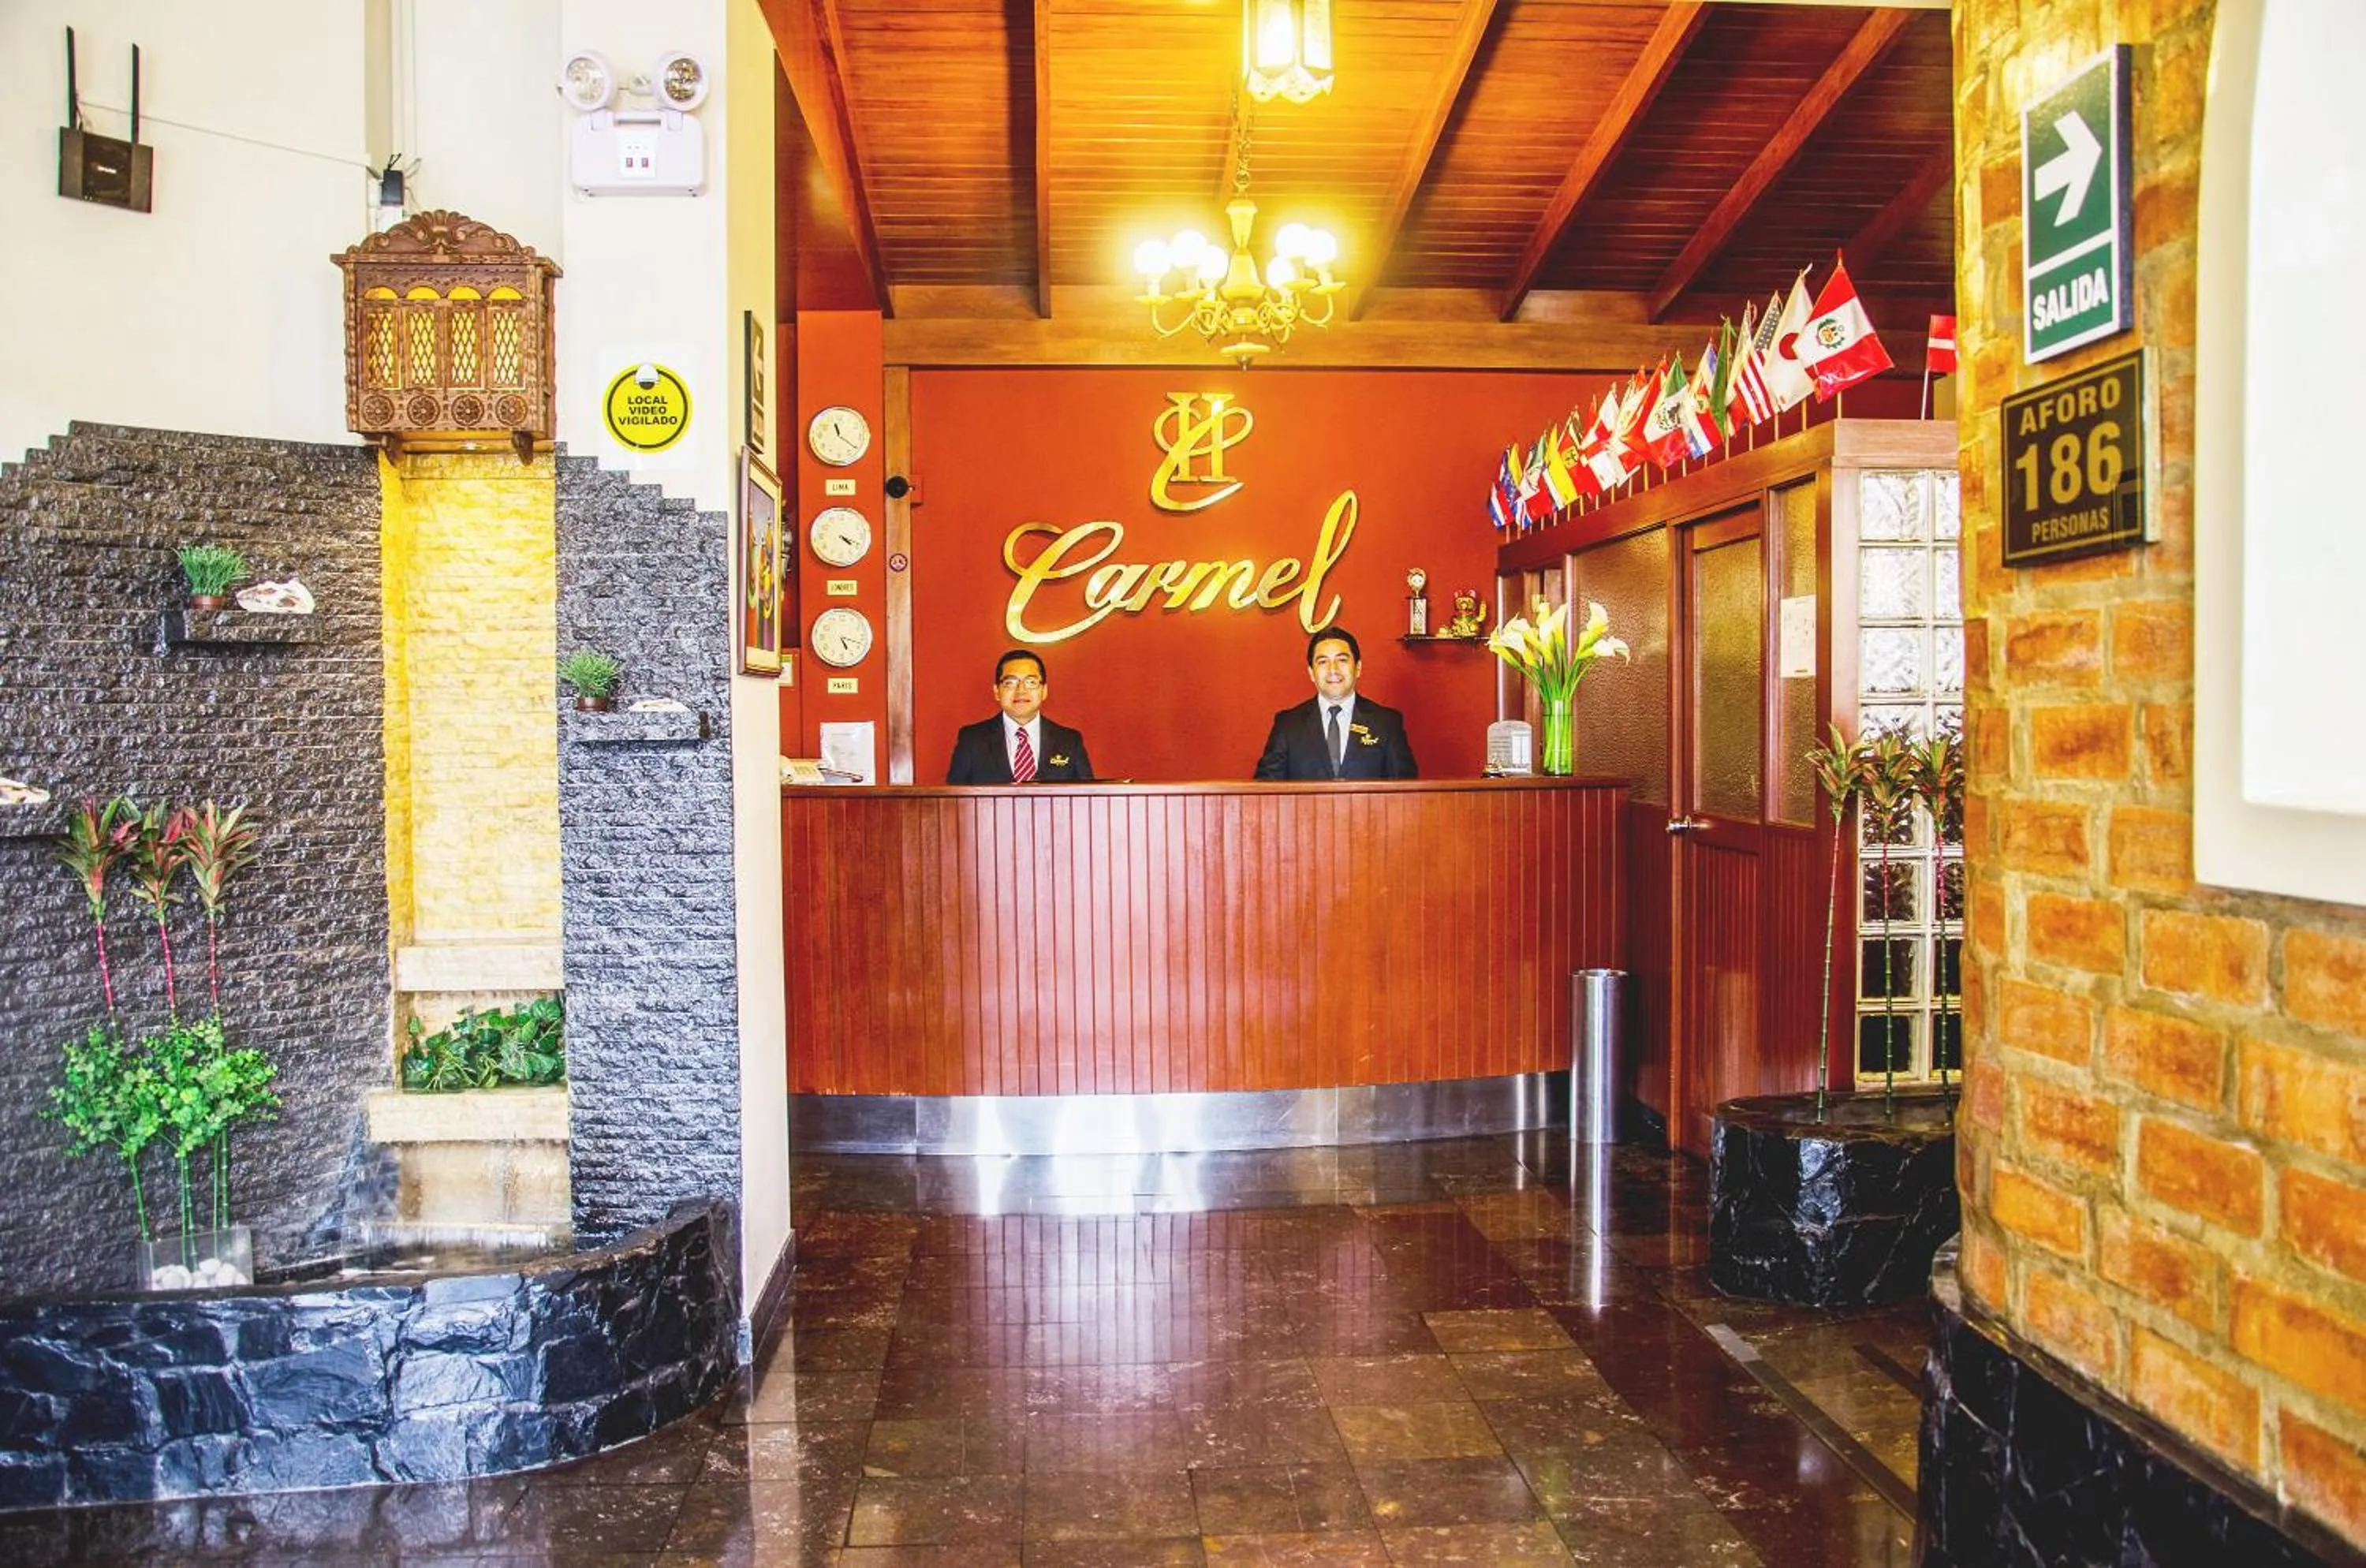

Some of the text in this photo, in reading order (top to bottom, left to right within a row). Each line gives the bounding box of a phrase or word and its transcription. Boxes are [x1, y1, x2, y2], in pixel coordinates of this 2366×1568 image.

[2032, 267, 2109, 331] SALIDA
[627, 395, 668, 405] LOCAL
[629, 406, 666, 415] VIDEO
[2019, 376, 2122, 436] AFORO
[618, 416, 677, 425] VIGILADO
[2015, 420, 2123, 512] 186
[832, 483, 849, 492] LIMA
[2032, 506, 2110, 543] PERSONAS
[1002, 489, 1359, 644] Carmel
